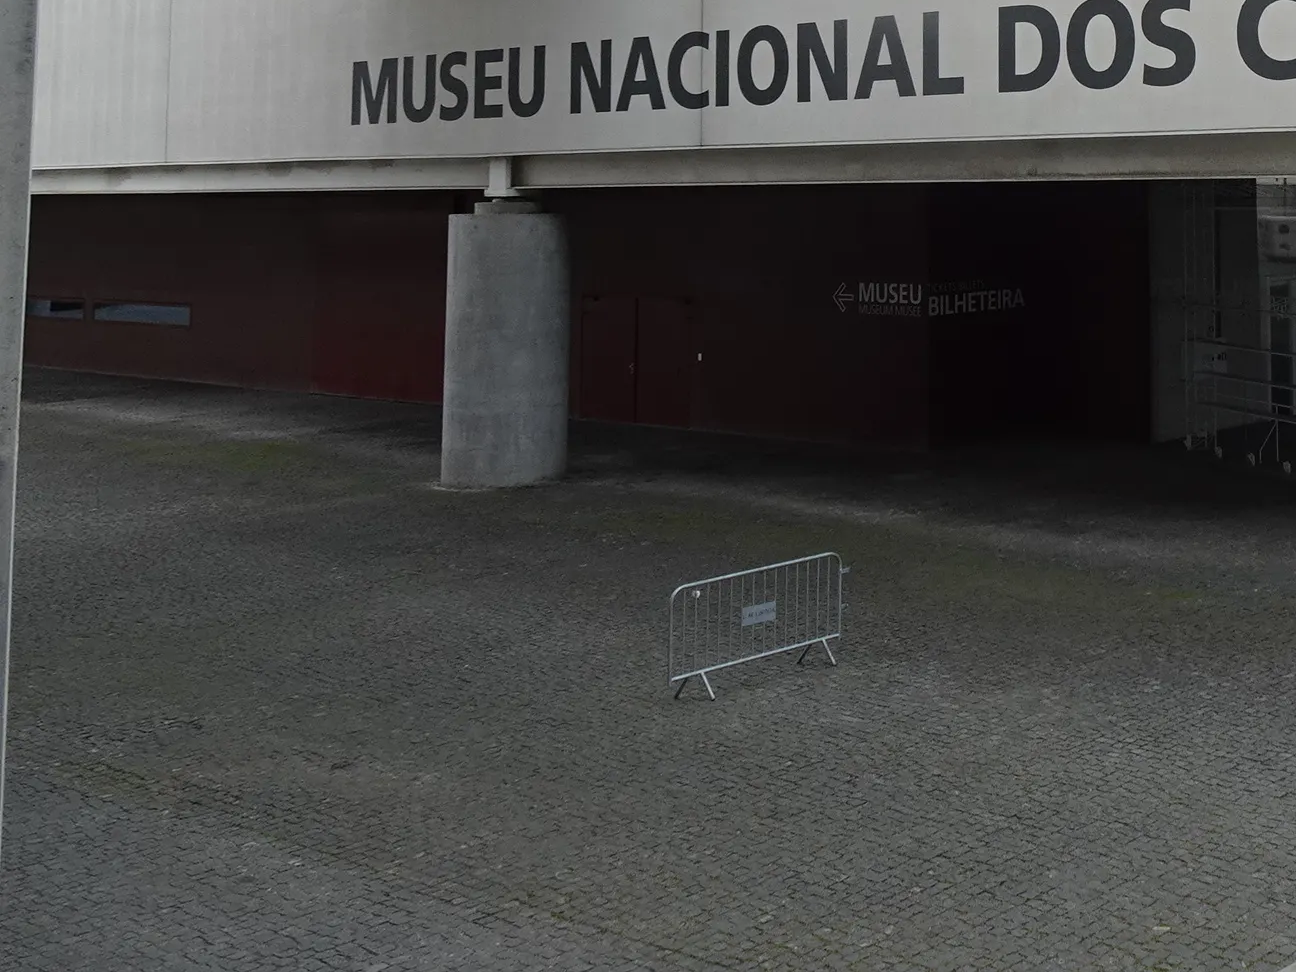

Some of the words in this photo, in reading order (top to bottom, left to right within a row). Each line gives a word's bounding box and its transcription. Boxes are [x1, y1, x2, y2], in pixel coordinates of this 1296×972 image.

[350, 45, 546, 126] MUSEU
[570, 11, 964, 114] NACIONAL
[858, 282, 922, 305] MUSEU
[928, 287, 1025, 316] BILHETEIRA
